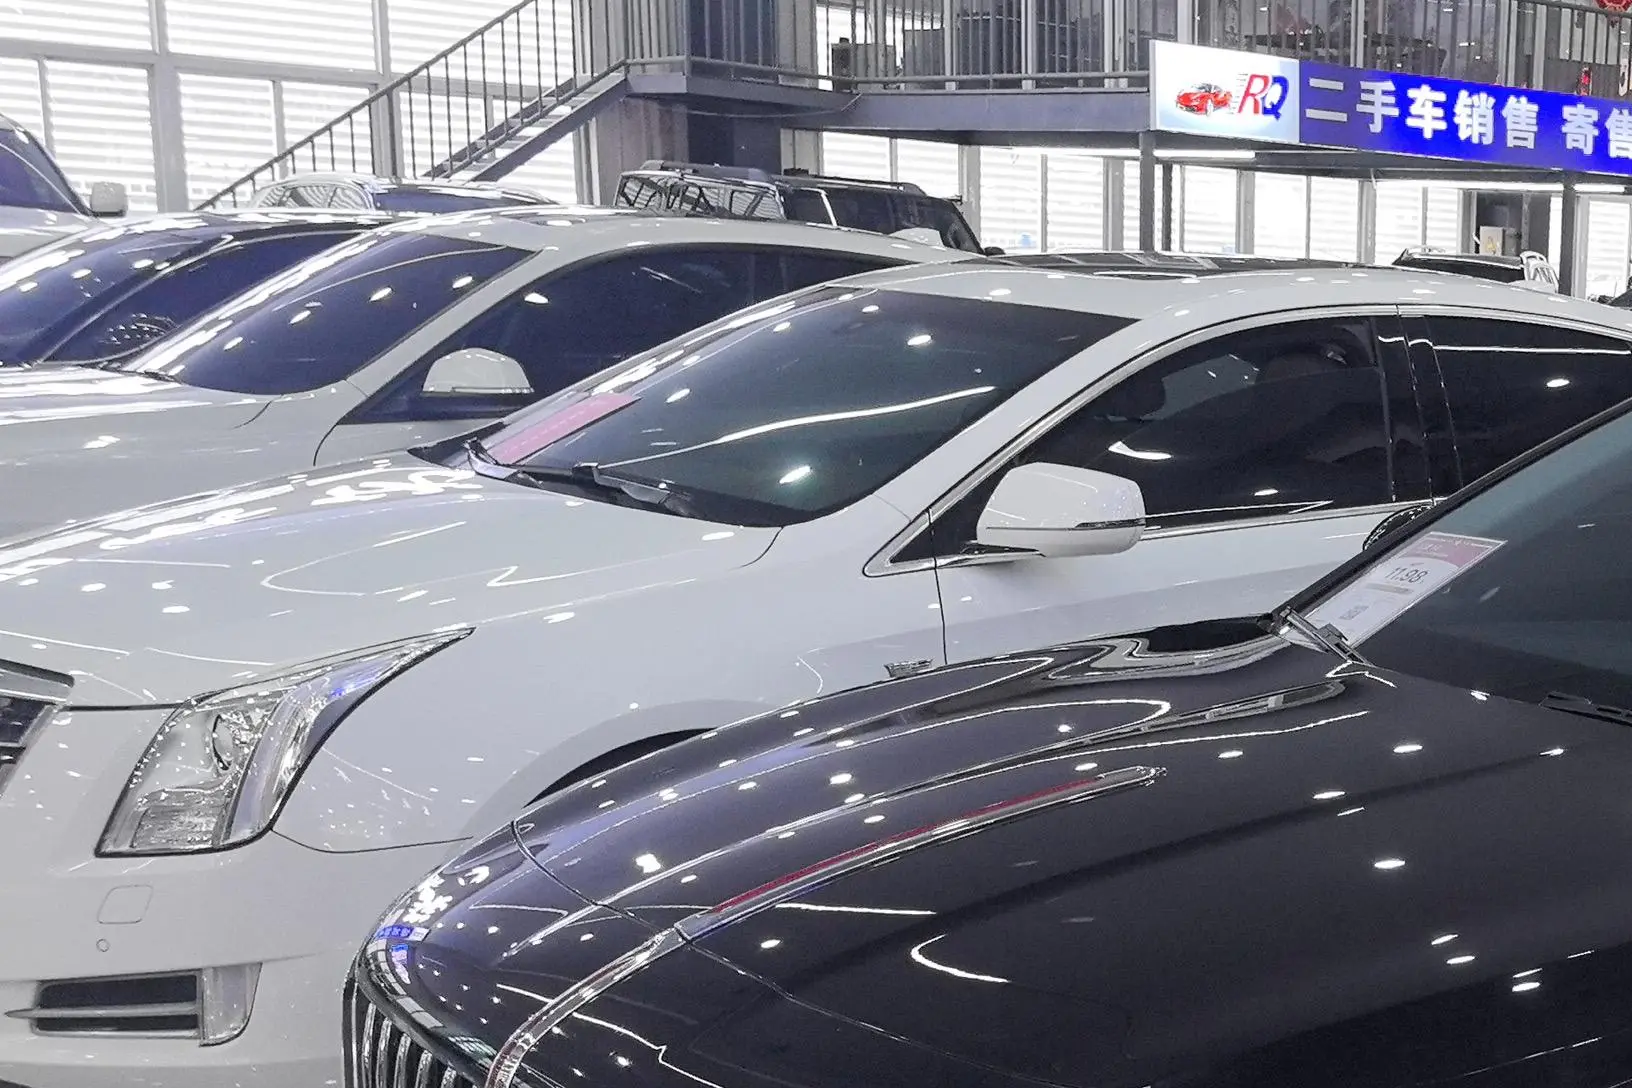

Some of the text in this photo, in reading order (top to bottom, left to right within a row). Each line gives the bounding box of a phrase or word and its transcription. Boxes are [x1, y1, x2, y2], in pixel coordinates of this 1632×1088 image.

[1238, 73, 1290, 120] RQ
[1305, 77, 1539, 151] 二手车销售
[1385, 566, 1430, 584] 11.98
